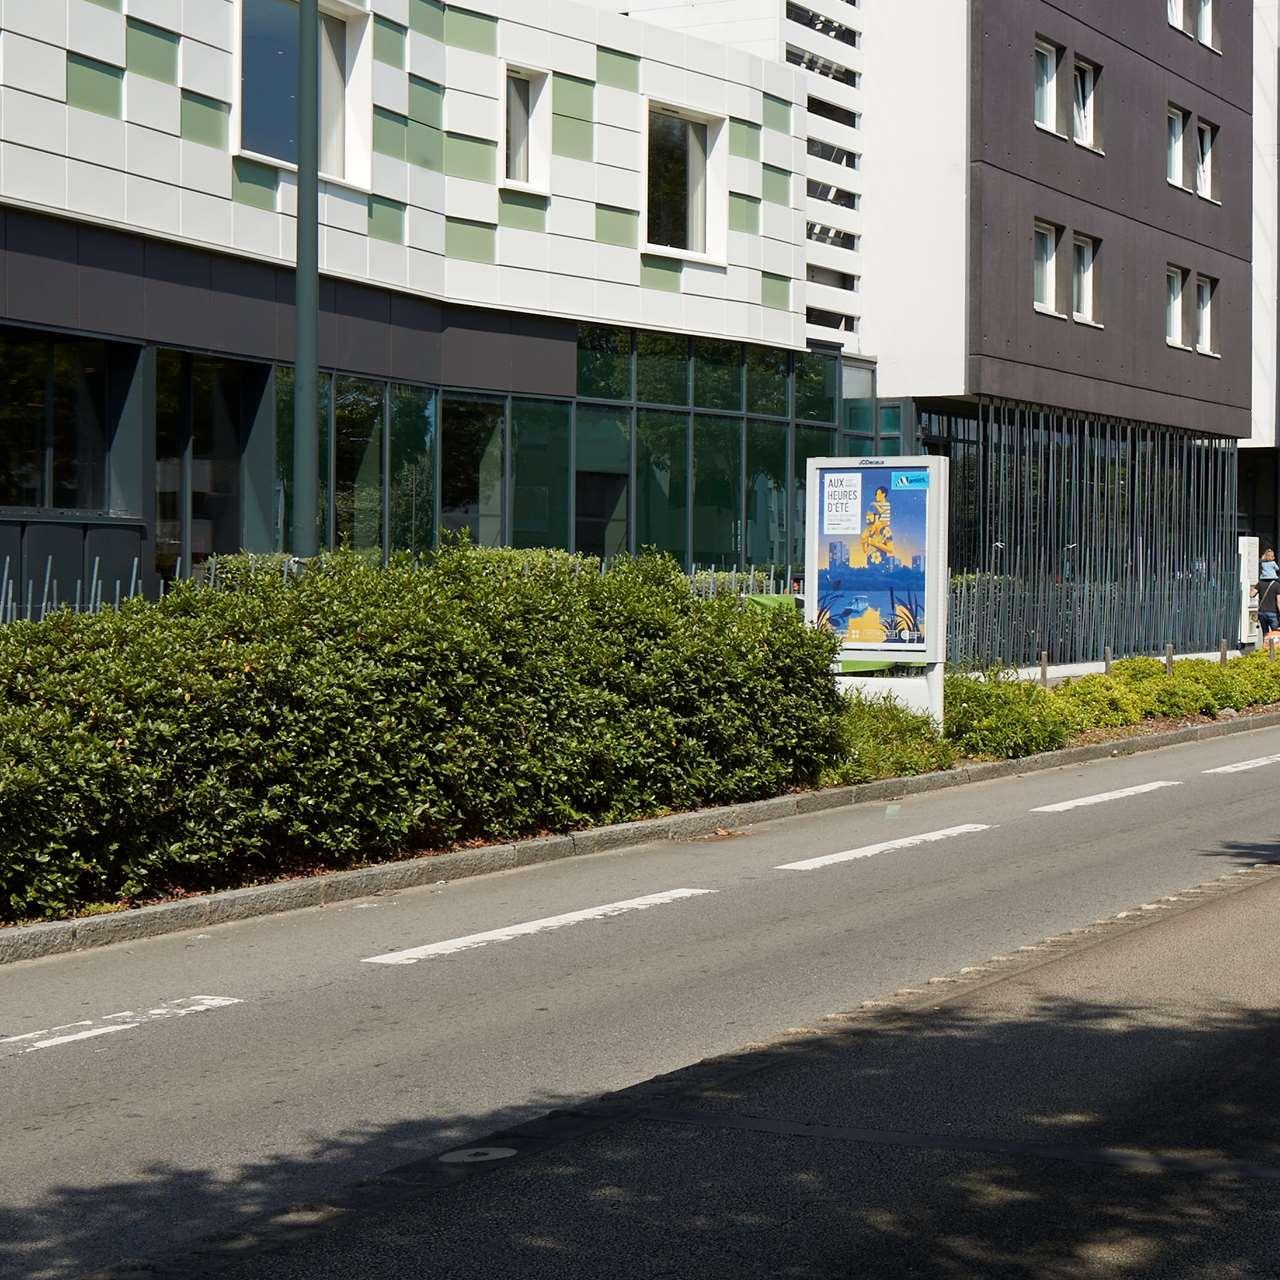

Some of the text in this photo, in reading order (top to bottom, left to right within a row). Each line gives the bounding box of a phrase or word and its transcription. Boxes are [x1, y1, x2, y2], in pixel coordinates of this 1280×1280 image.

[828, 478, 845, 489] AUX
[827, 490, 858, 501] HEURES
[827, 500, 850, 513] D'ÉTÉ
